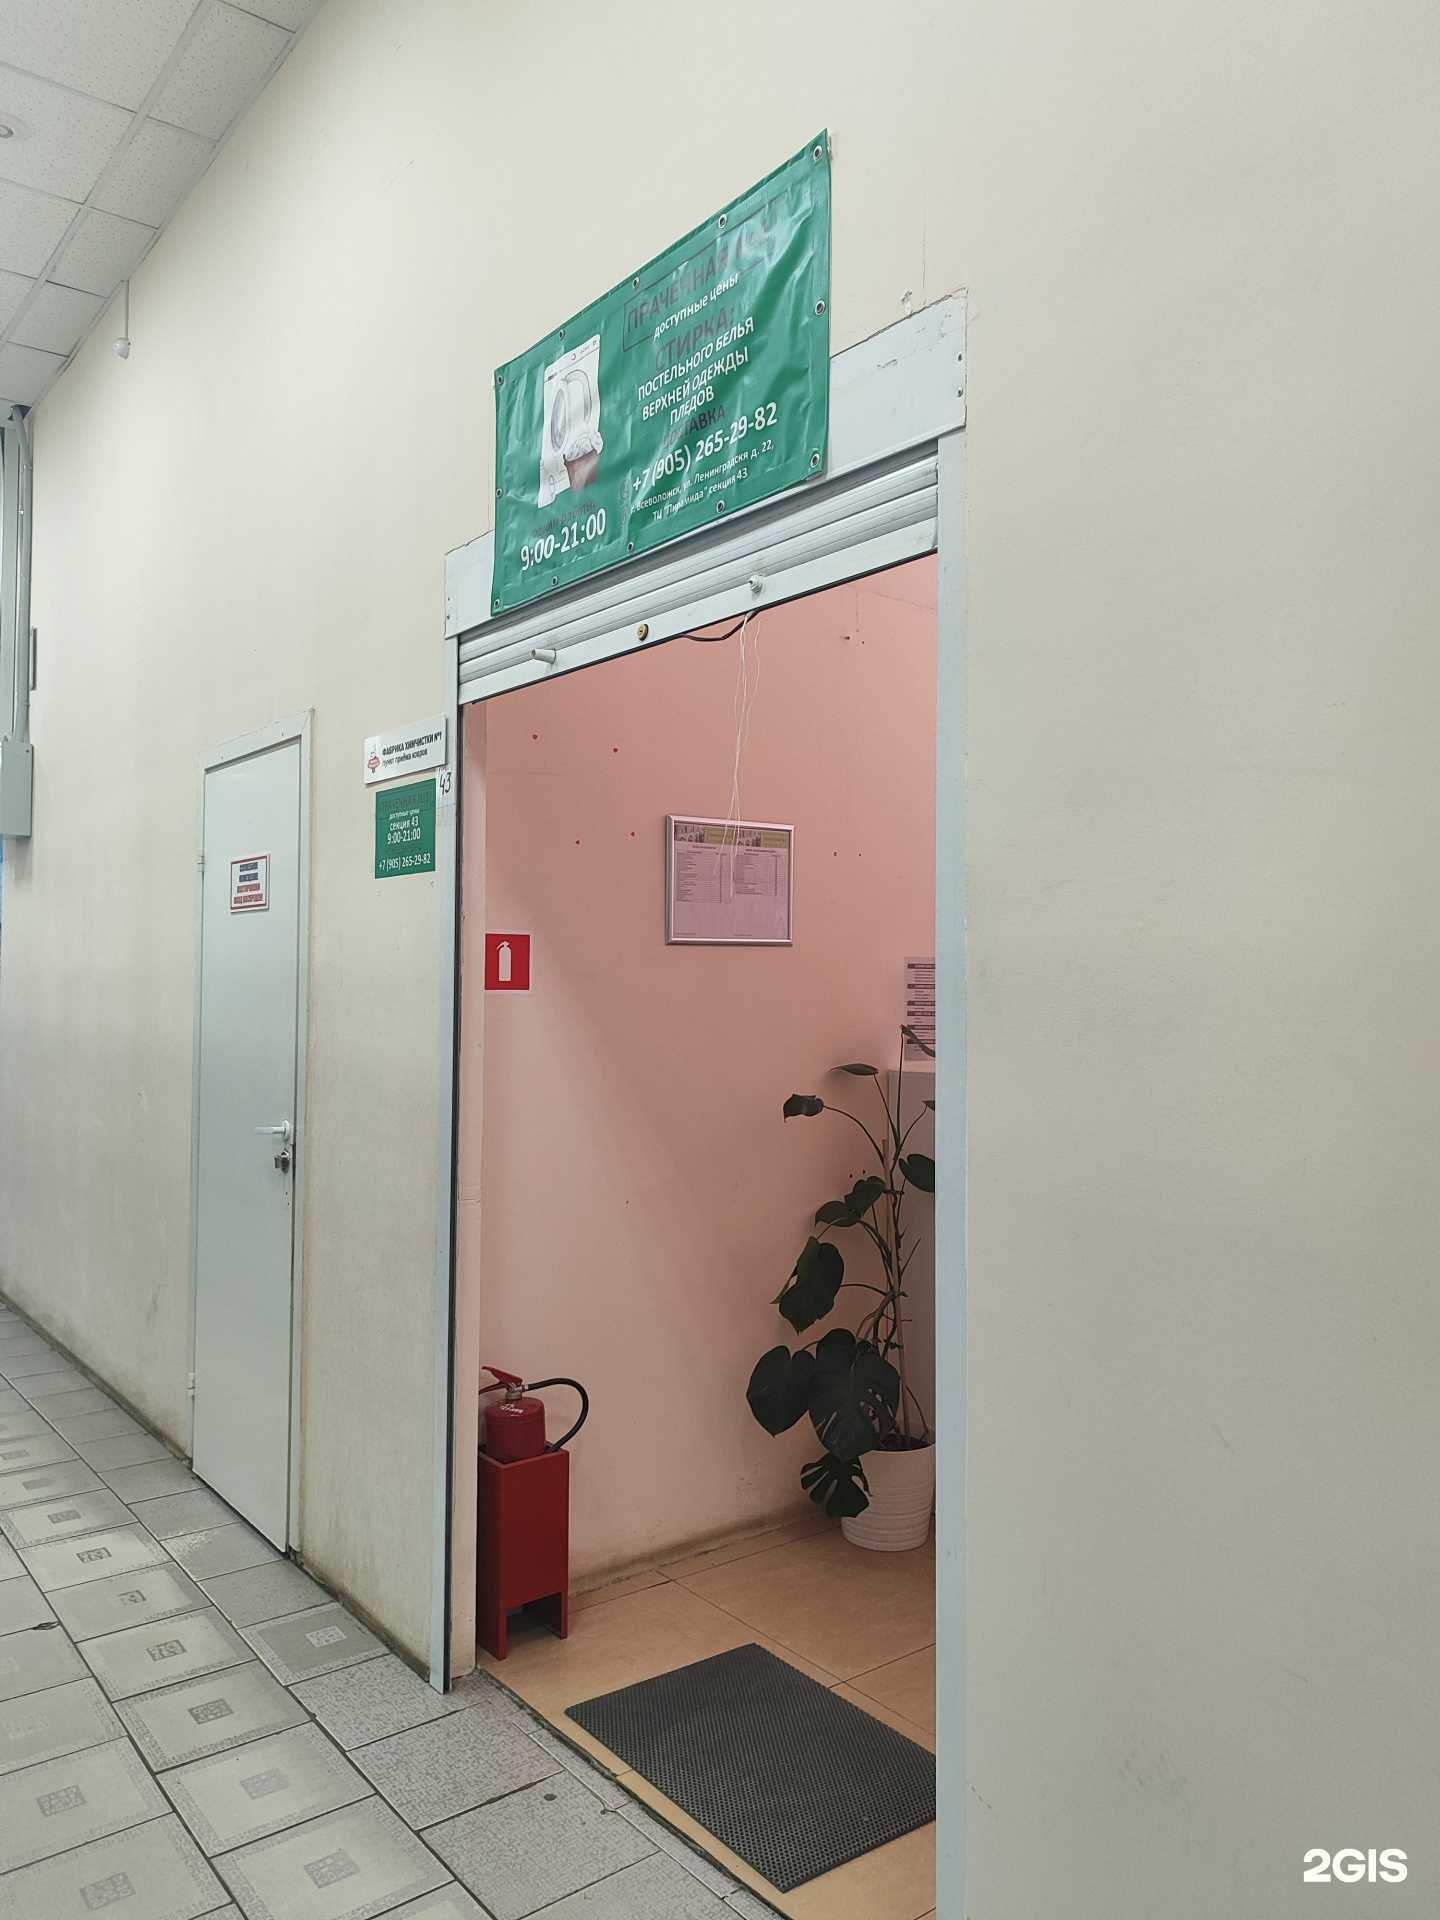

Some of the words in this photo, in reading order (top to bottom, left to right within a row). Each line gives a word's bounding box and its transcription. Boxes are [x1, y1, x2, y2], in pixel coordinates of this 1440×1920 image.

[653, 295, 708, 341] доступные
[709, 273, 738, 303] цены
[638, 342, 714, 401] ПОСТЕЛЬНОГО
[715, 317, 754, 352] БЕЛЬЯ
[642, 378, 691, 421] ВЕРХНЕЙ
[692, 346, 748, 391] ОДЕЖДЫ
[670, 386, 714, 425] ПЛЕДОВ
[695, 402, 778, 462] 265-29-82
[736, 467, 748, 480] 43
[521, 508, 606, 571] 9:00-21:00
[387, 828, 420, 844] 9:00-21:00
[390, 819, 410, 831] секция
[411, 815, 419, 827] 43
[401, 853, 431, 867] 265-29-82
